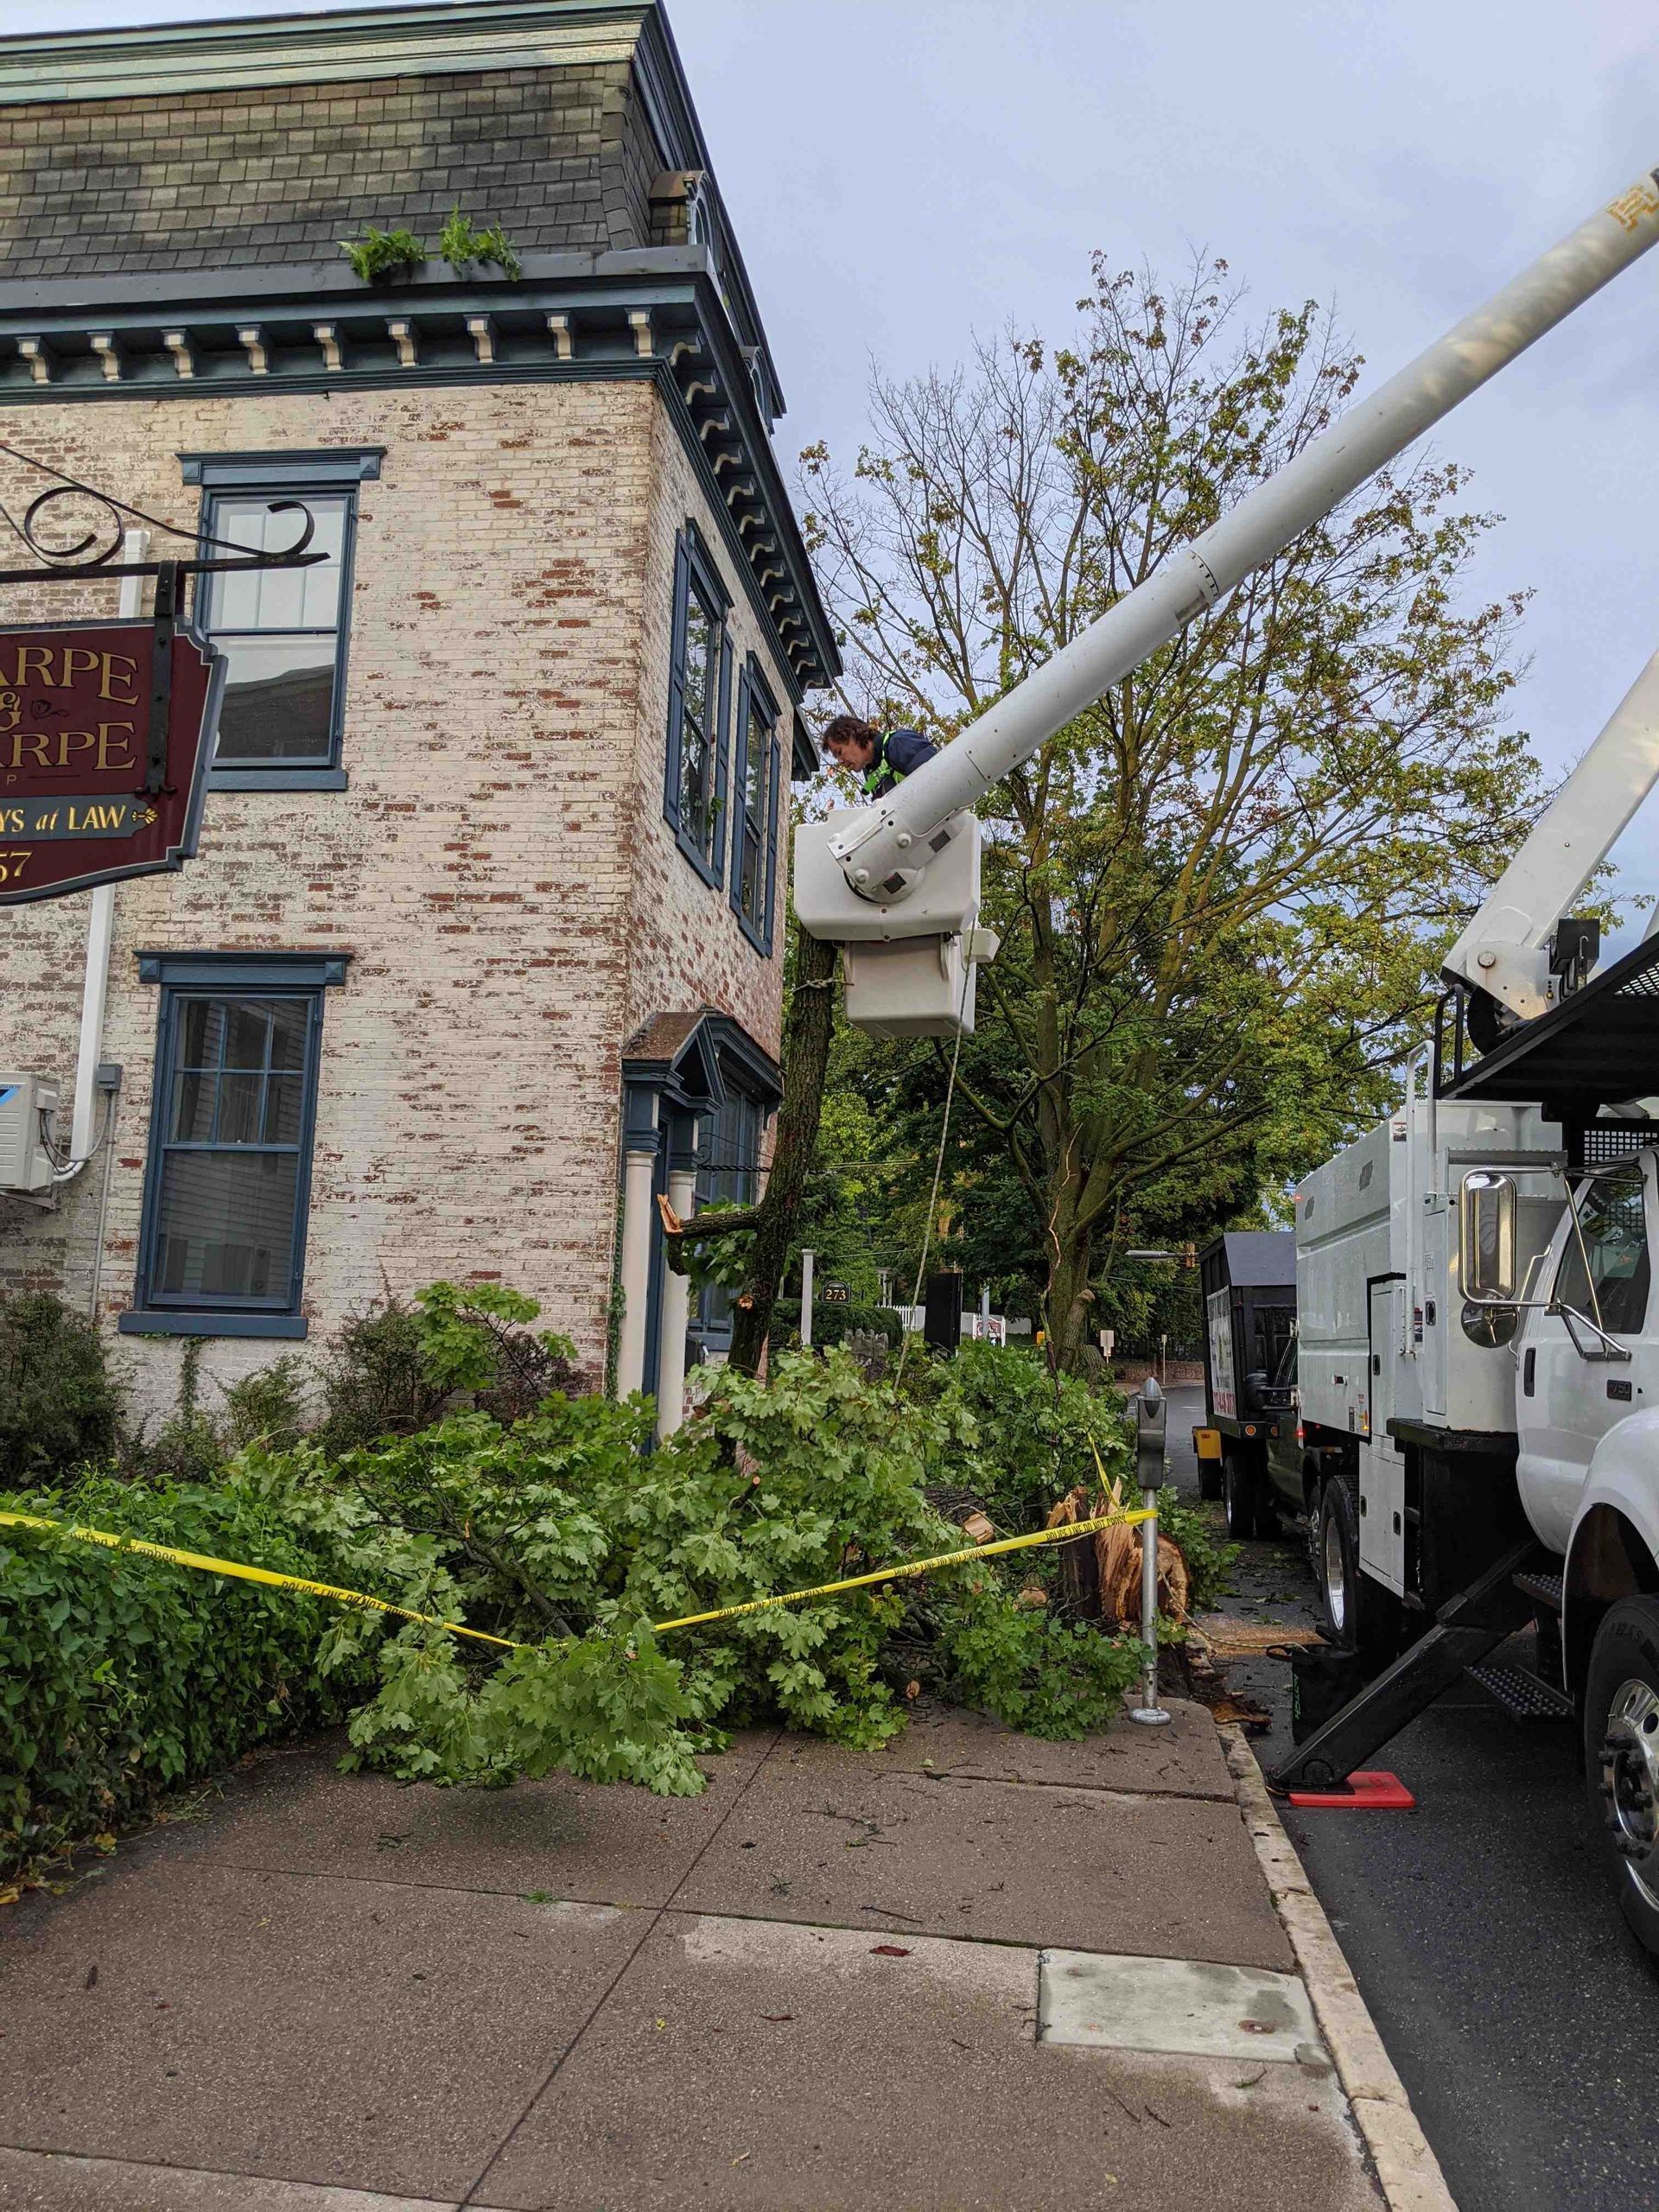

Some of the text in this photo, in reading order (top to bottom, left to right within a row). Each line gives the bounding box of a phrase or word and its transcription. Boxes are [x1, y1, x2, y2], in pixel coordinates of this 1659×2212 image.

[0, 722, 137, 771] RPE
[35, 808, 60, 831] at
[68, 804, 127, 830] LAW
[825, 1288, 847, 1300] 273
